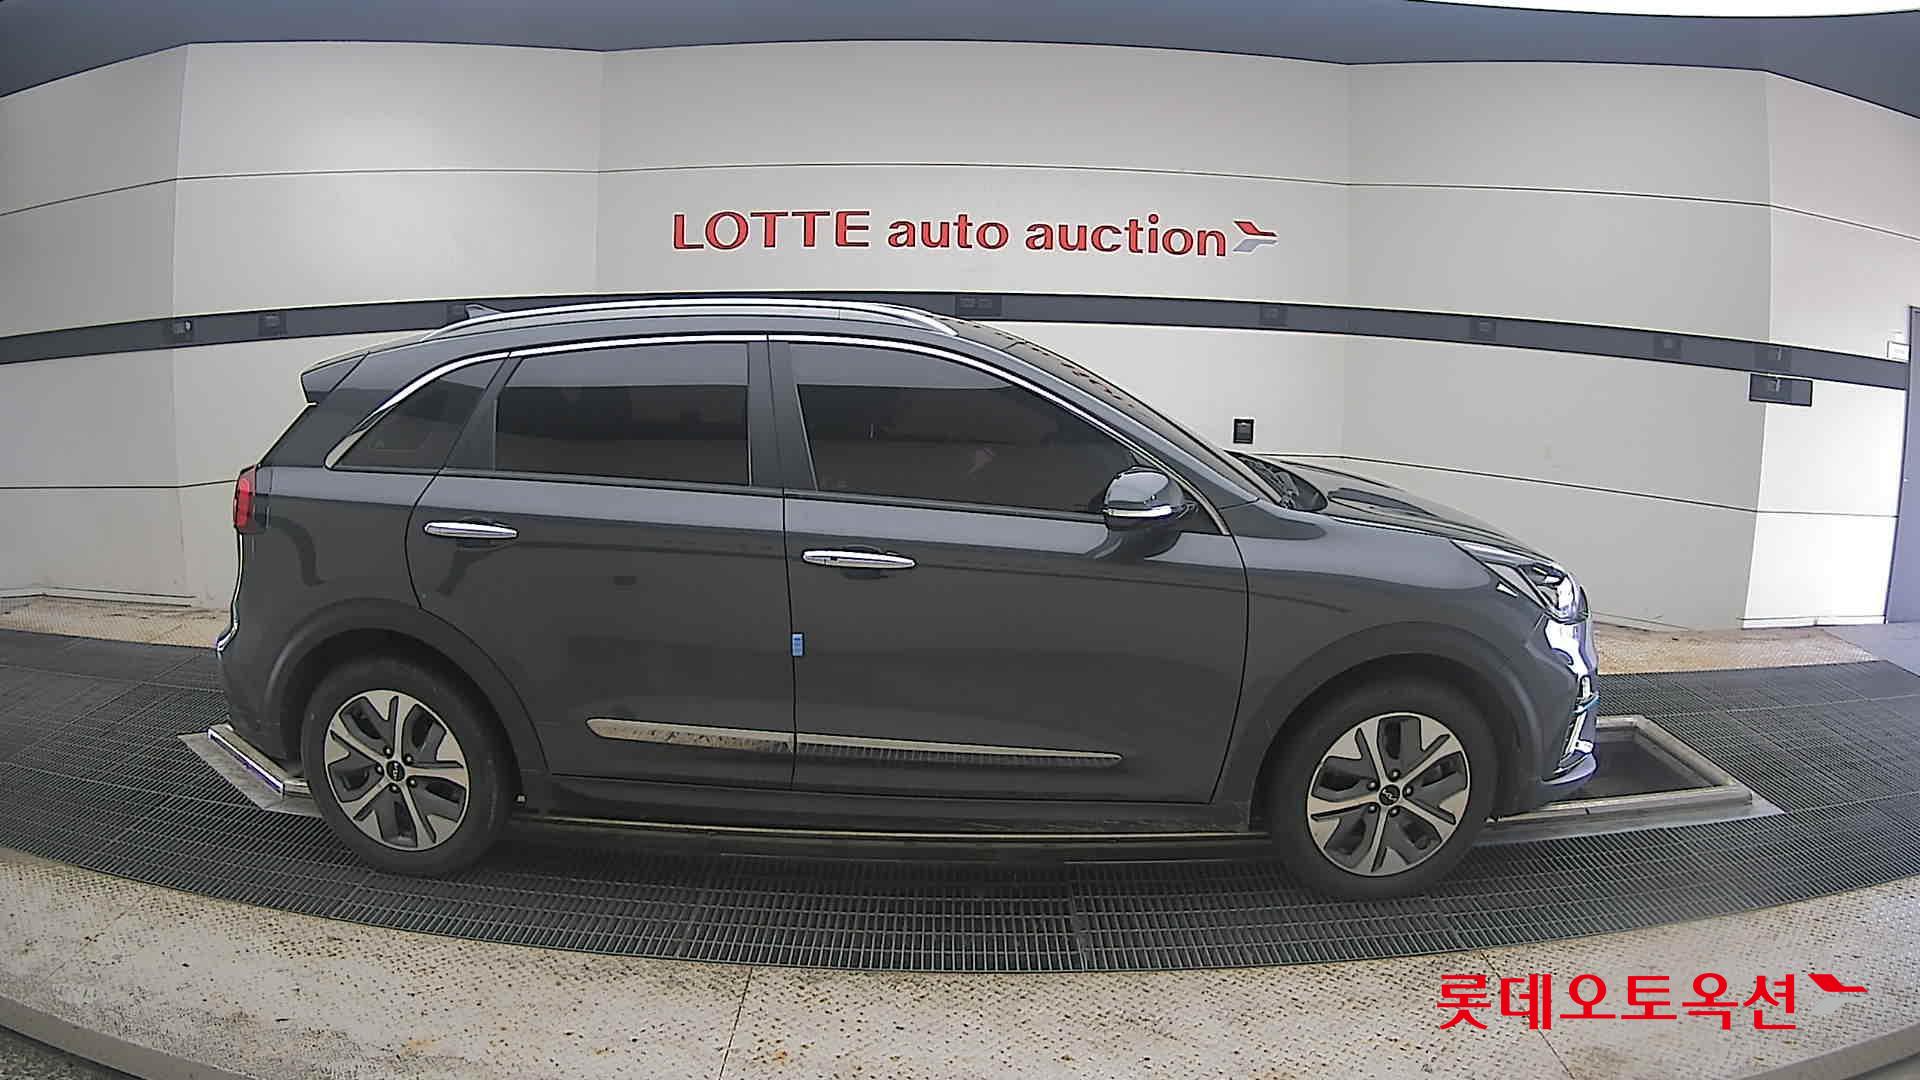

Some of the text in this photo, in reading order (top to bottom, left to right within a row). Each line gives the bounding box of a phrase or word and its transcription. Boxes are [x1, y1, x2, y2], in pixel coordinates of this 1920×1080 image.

[673, 211, 1227, 257] LOTTE auto auction
